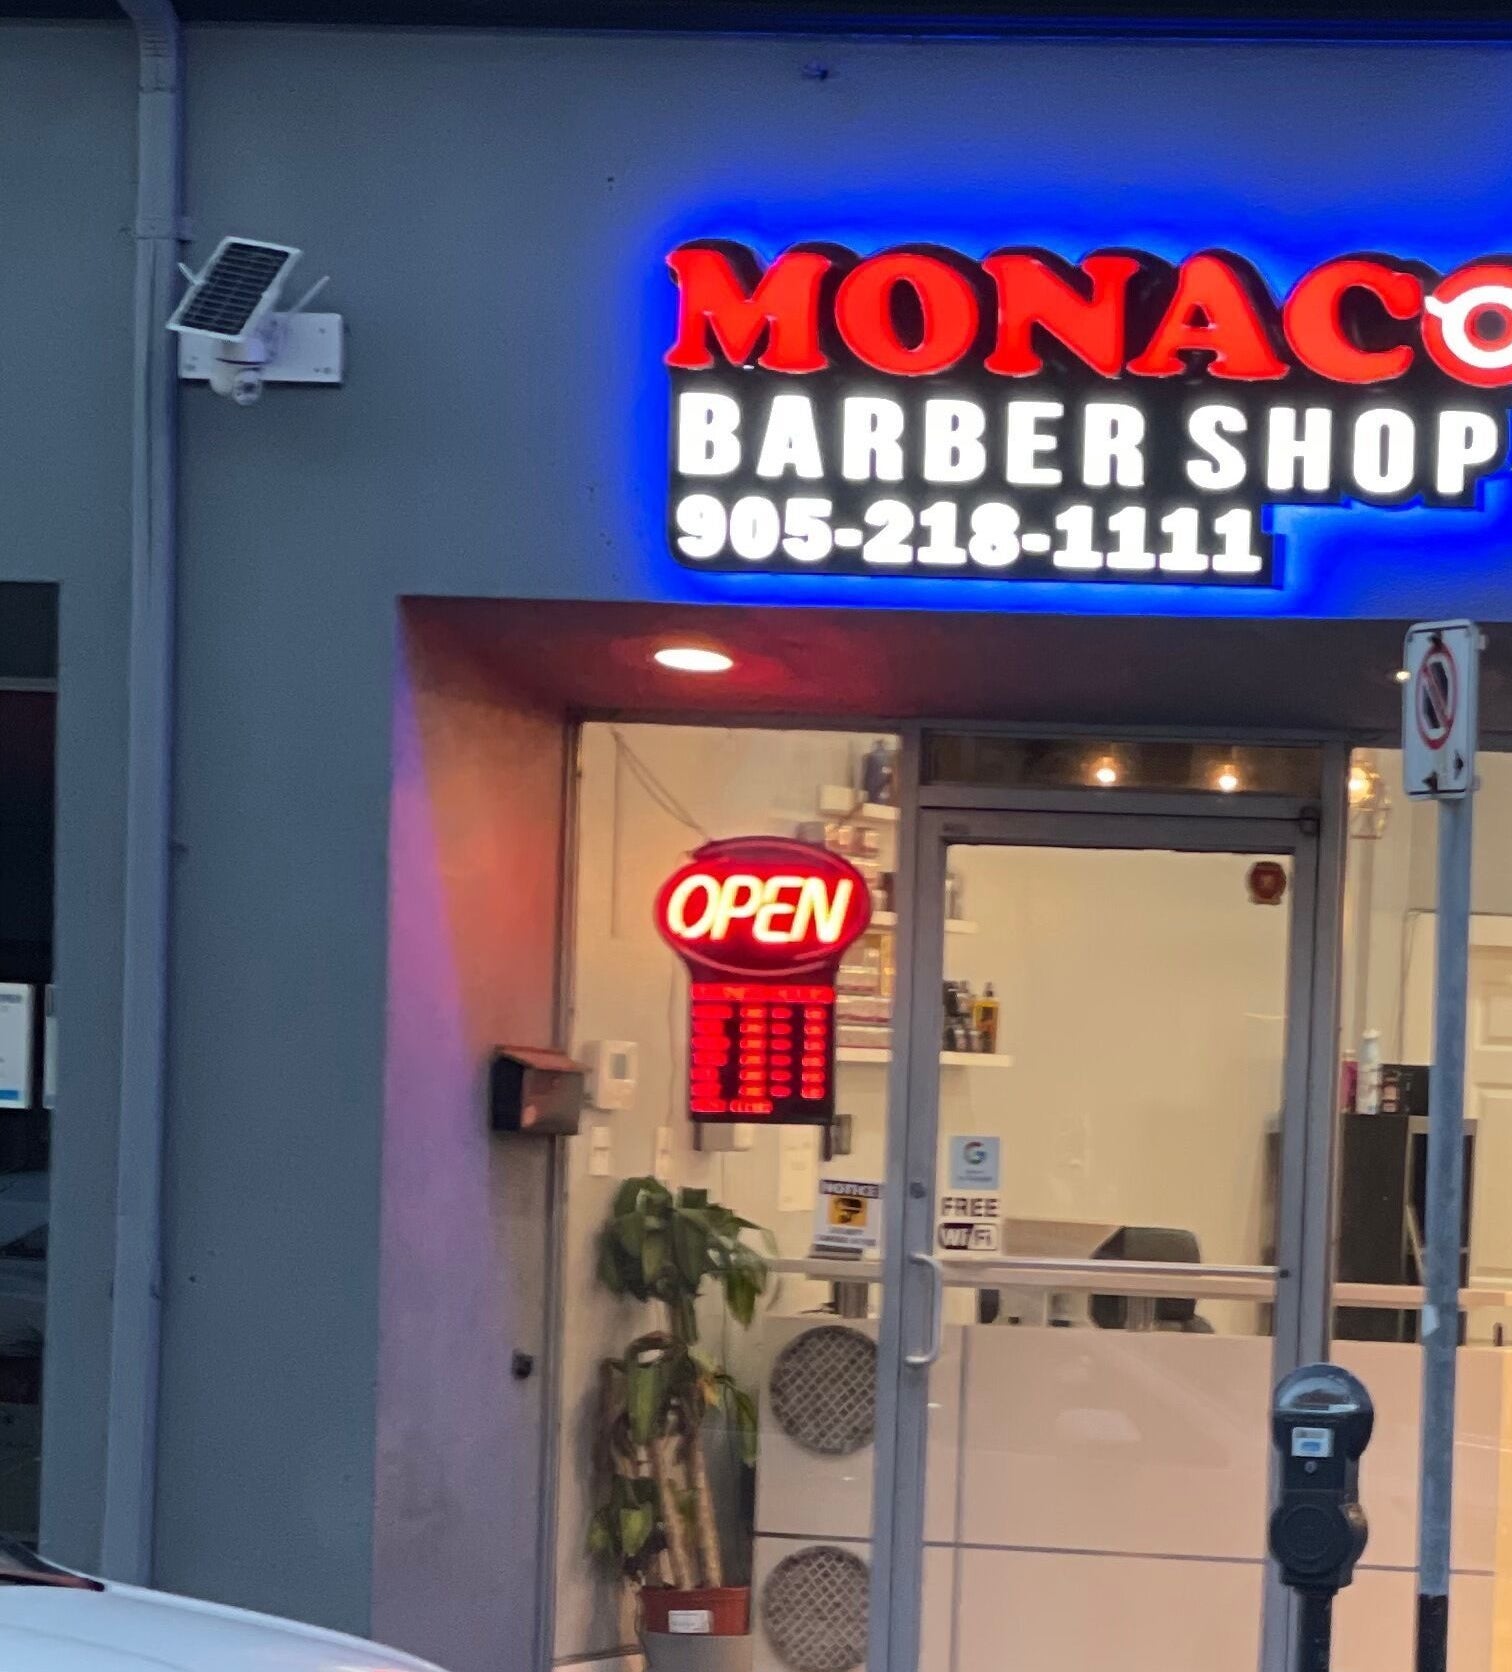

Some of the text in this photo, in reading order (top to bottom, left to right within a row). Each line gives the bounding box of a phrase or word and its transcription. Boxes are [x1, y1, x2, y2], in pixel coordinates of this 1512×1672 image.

[677, 391, 1499, 494] BARBER SHOP
[676, 494, 1262, 572] 905-218-1111
[667, 874, 853, 943] OPEN
[942, 1197, 999, 1217] FREE
